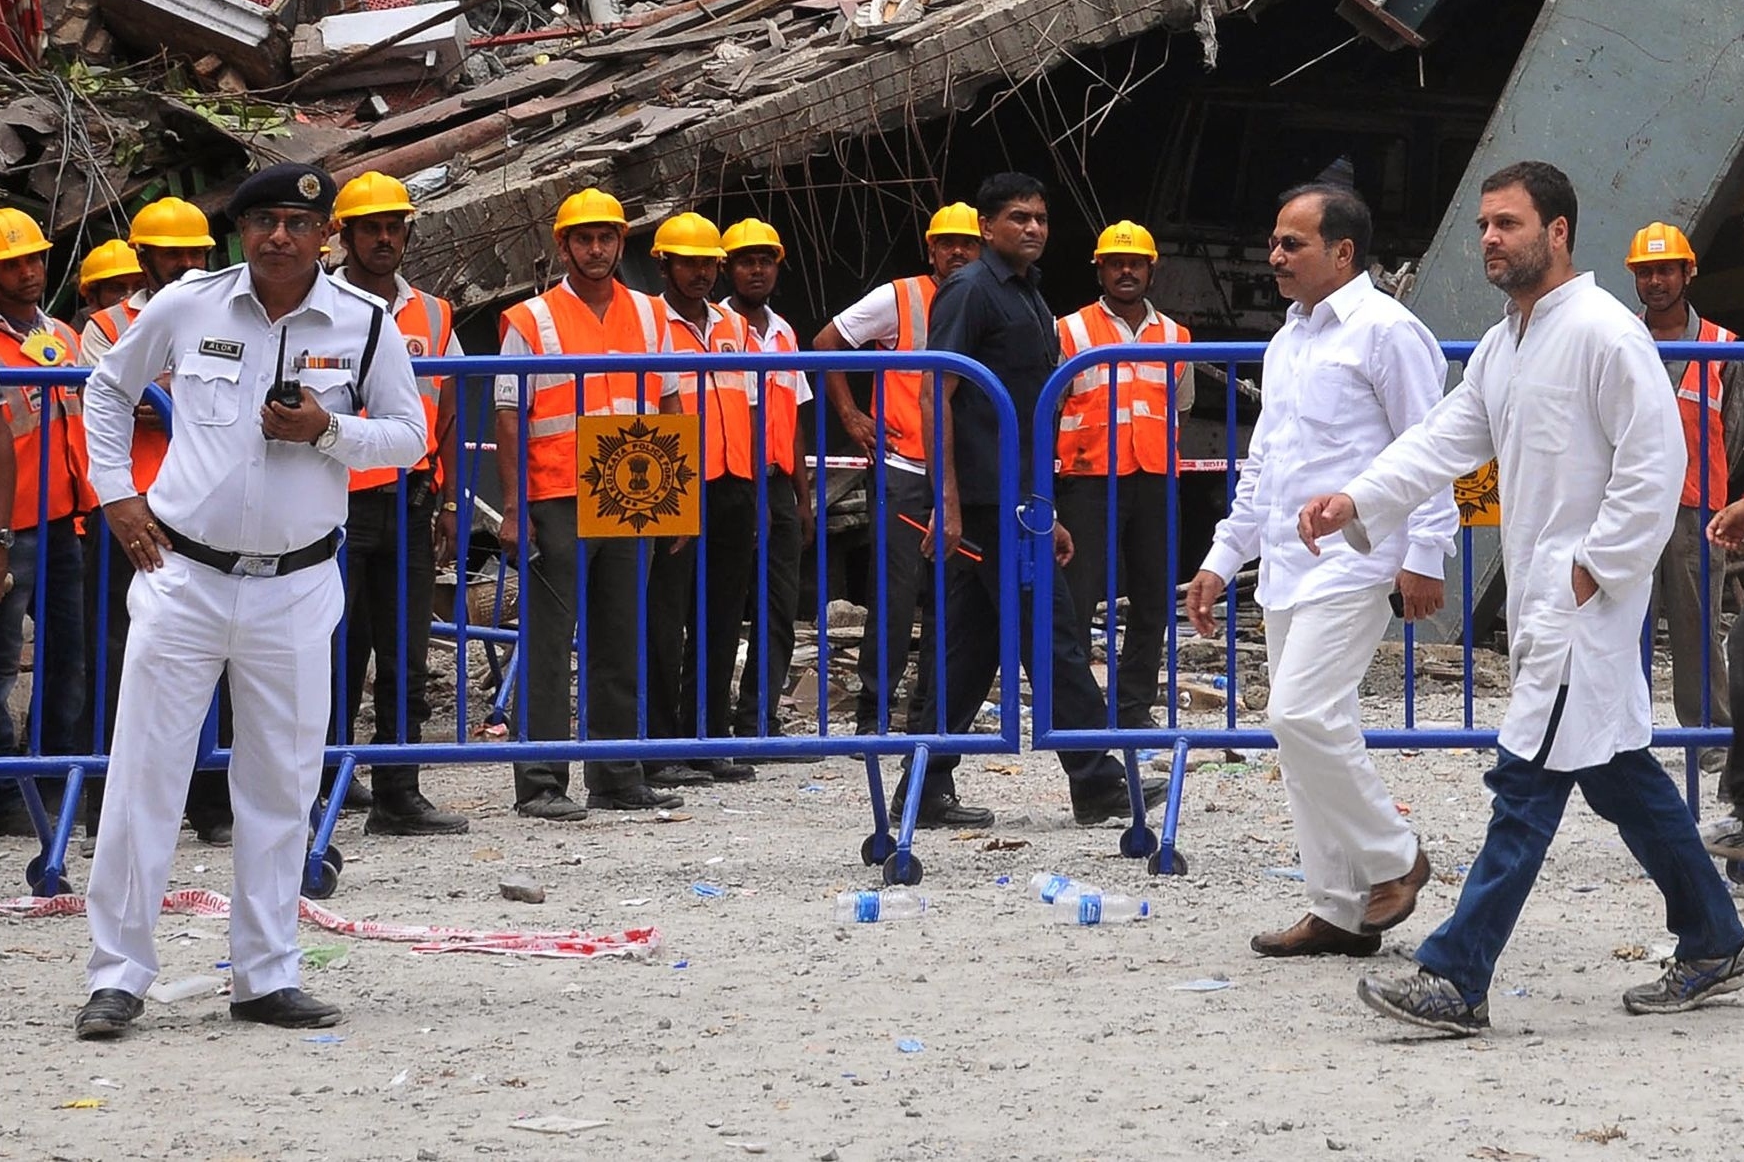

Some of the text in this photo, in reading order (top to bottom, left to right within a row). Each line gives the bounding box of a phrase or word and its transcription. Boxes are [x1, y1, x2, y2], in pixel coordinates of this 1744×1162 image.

[208, 342, 233, 352] ALOK
[605, 442, 672, 493] KOLKATA POLICE FORCE
